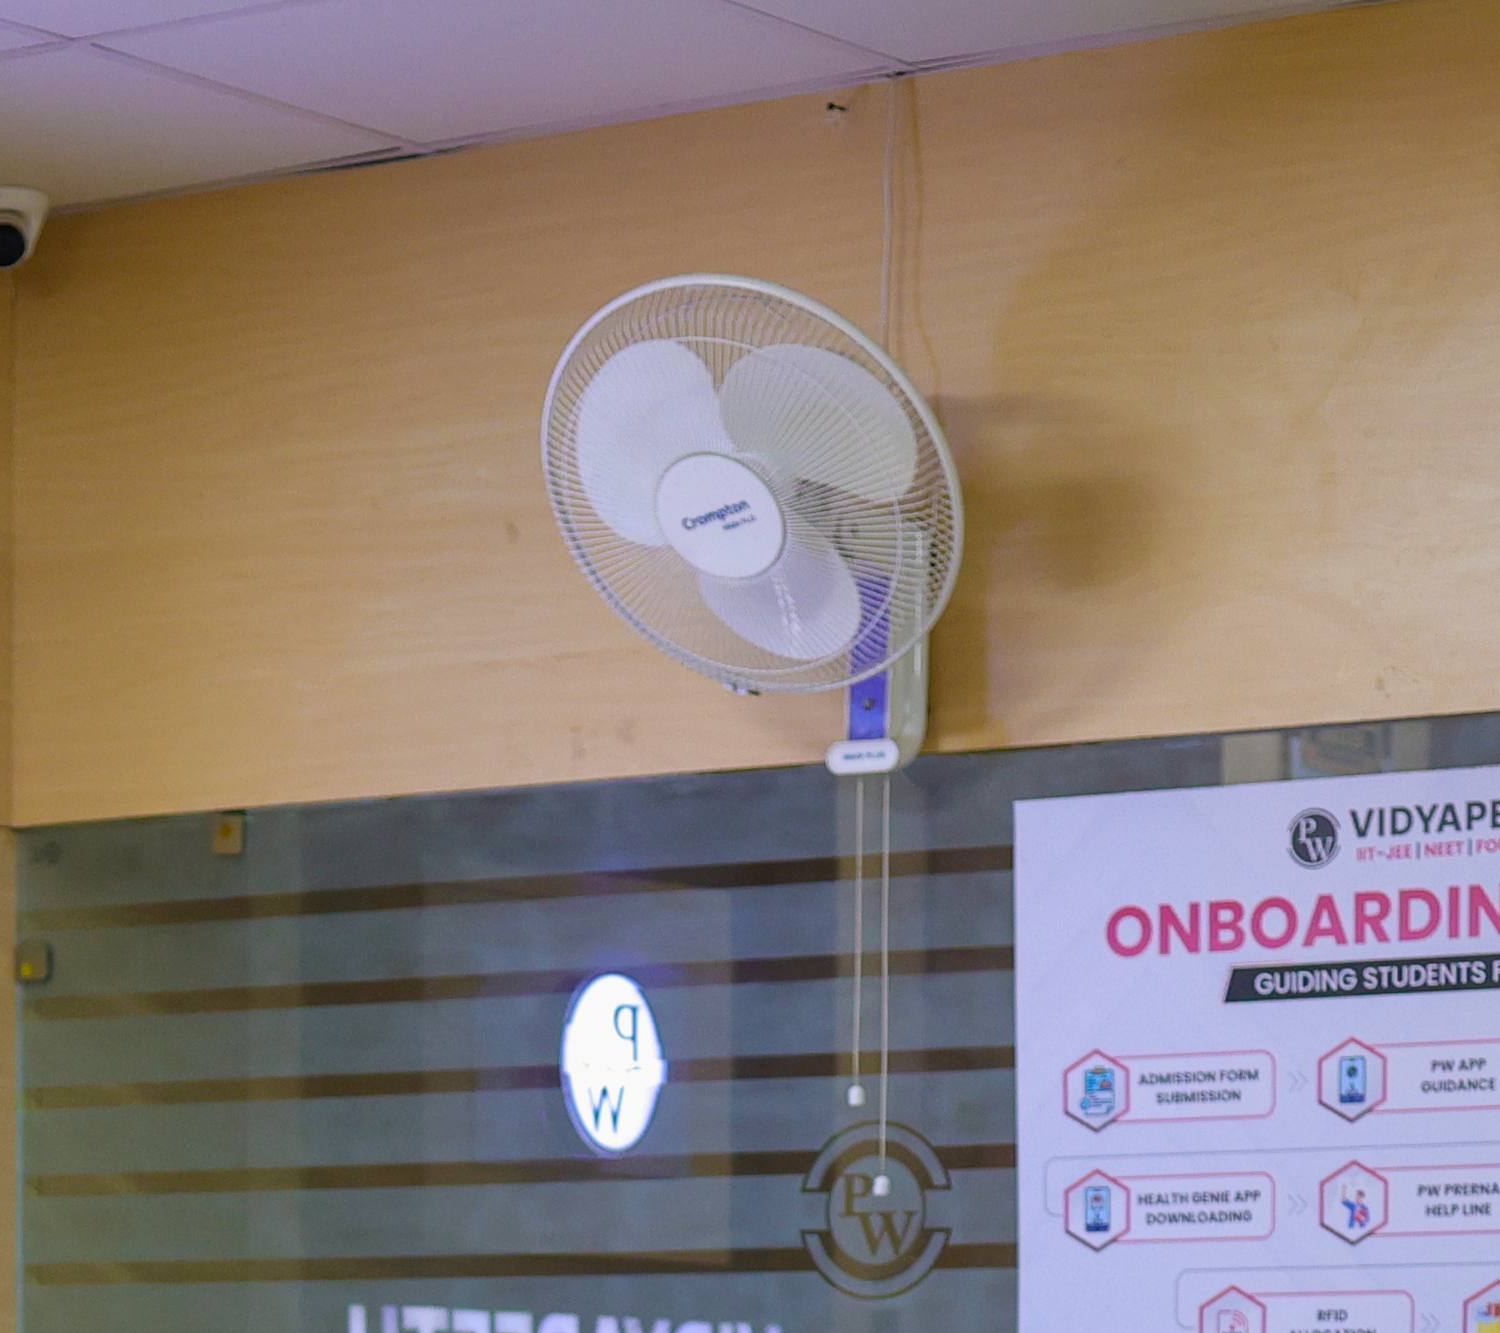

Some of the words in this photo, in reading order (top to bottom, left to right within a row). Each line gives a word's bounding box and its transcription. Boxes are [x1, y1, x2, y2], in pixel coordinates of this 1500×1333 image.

[681, 500, 749, 532] Crompton
[1254, 967, 1356, 996] GUIDING
[1363, 959, 1487, 990] STUDENTS
